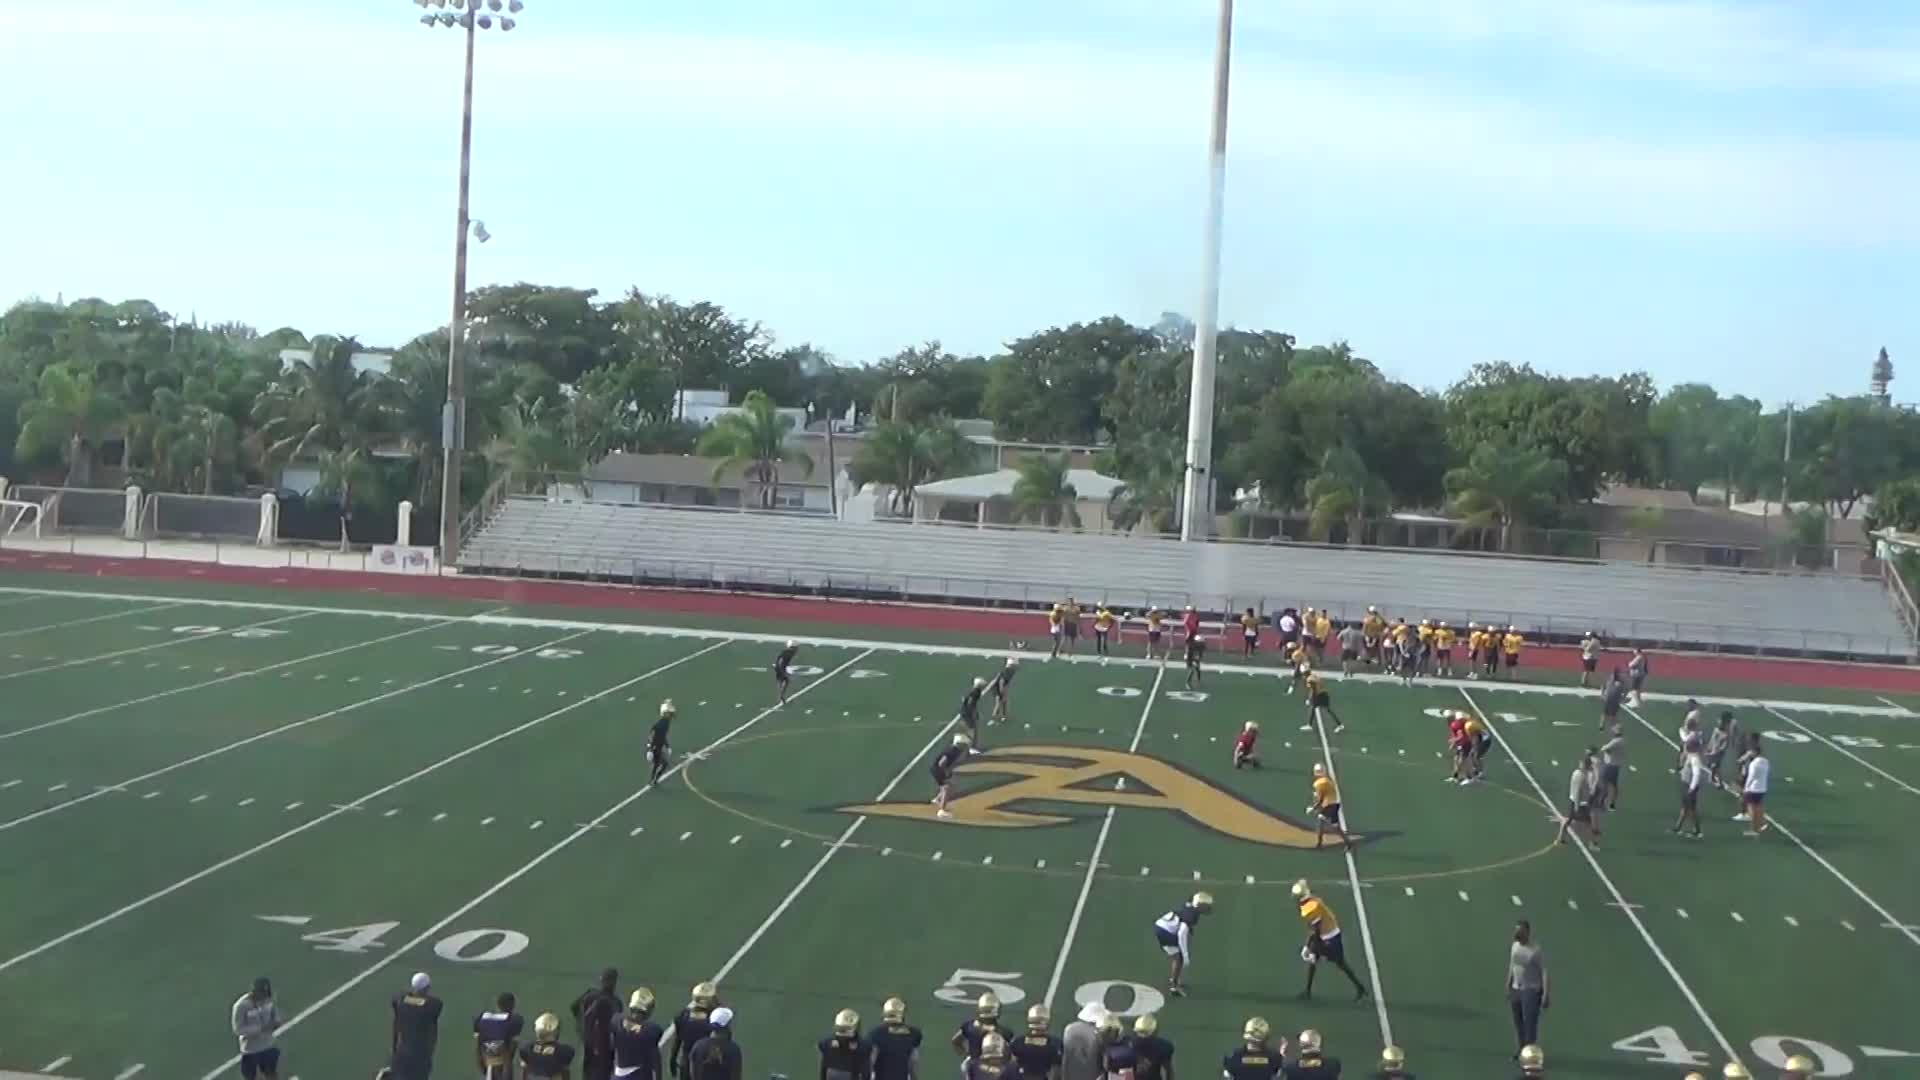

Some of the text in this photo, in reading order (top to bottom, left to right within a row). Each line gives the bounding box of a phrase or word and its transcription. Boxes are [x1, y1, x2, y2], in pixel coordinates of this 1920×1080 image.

[301, 920, 530, 963] 40
[934, 967, 1165, 1018] 50
[1611, 1025, 1855, 1077] 40
